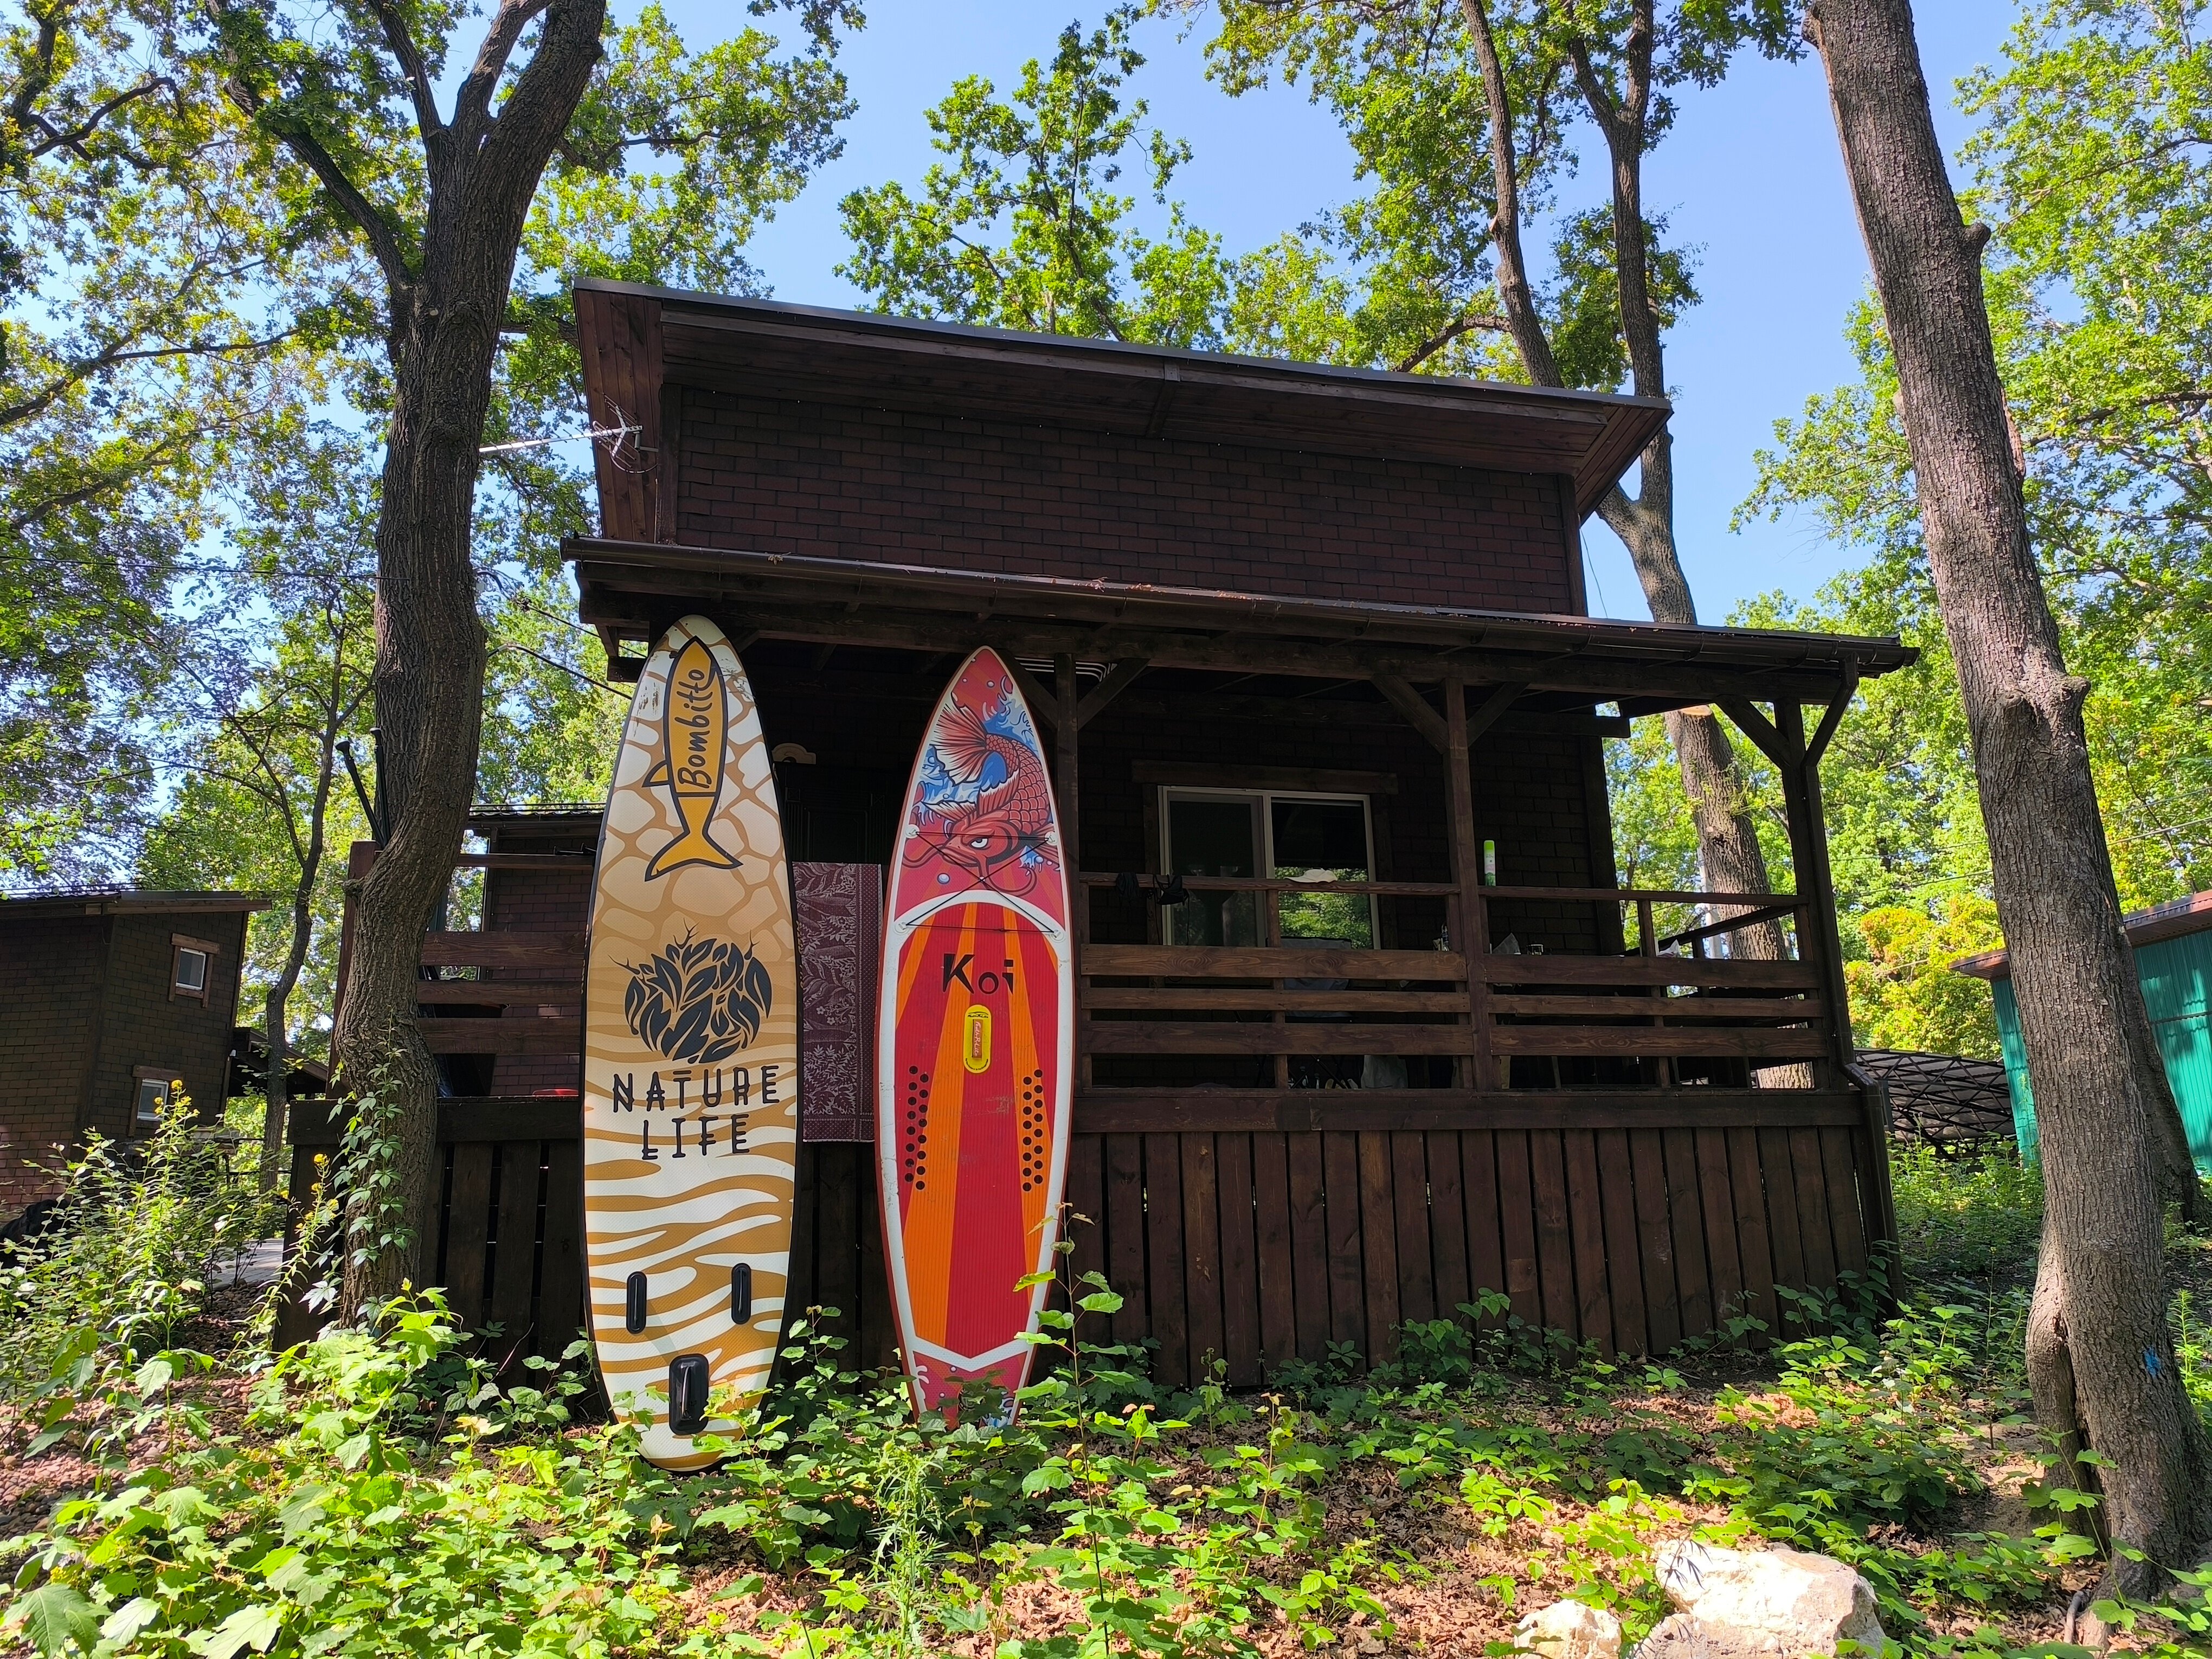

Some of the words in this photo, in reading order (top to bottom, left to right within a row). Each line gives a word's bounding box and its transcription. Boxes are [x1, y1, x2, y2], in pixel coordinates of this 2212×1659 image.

[674, 669, 713, 788] Bombitto
[942, 953, 1014, 994] Koi
[613, 1065, 780, 1113] NATURE
[641, 1114, 750, 1160] LIFE
